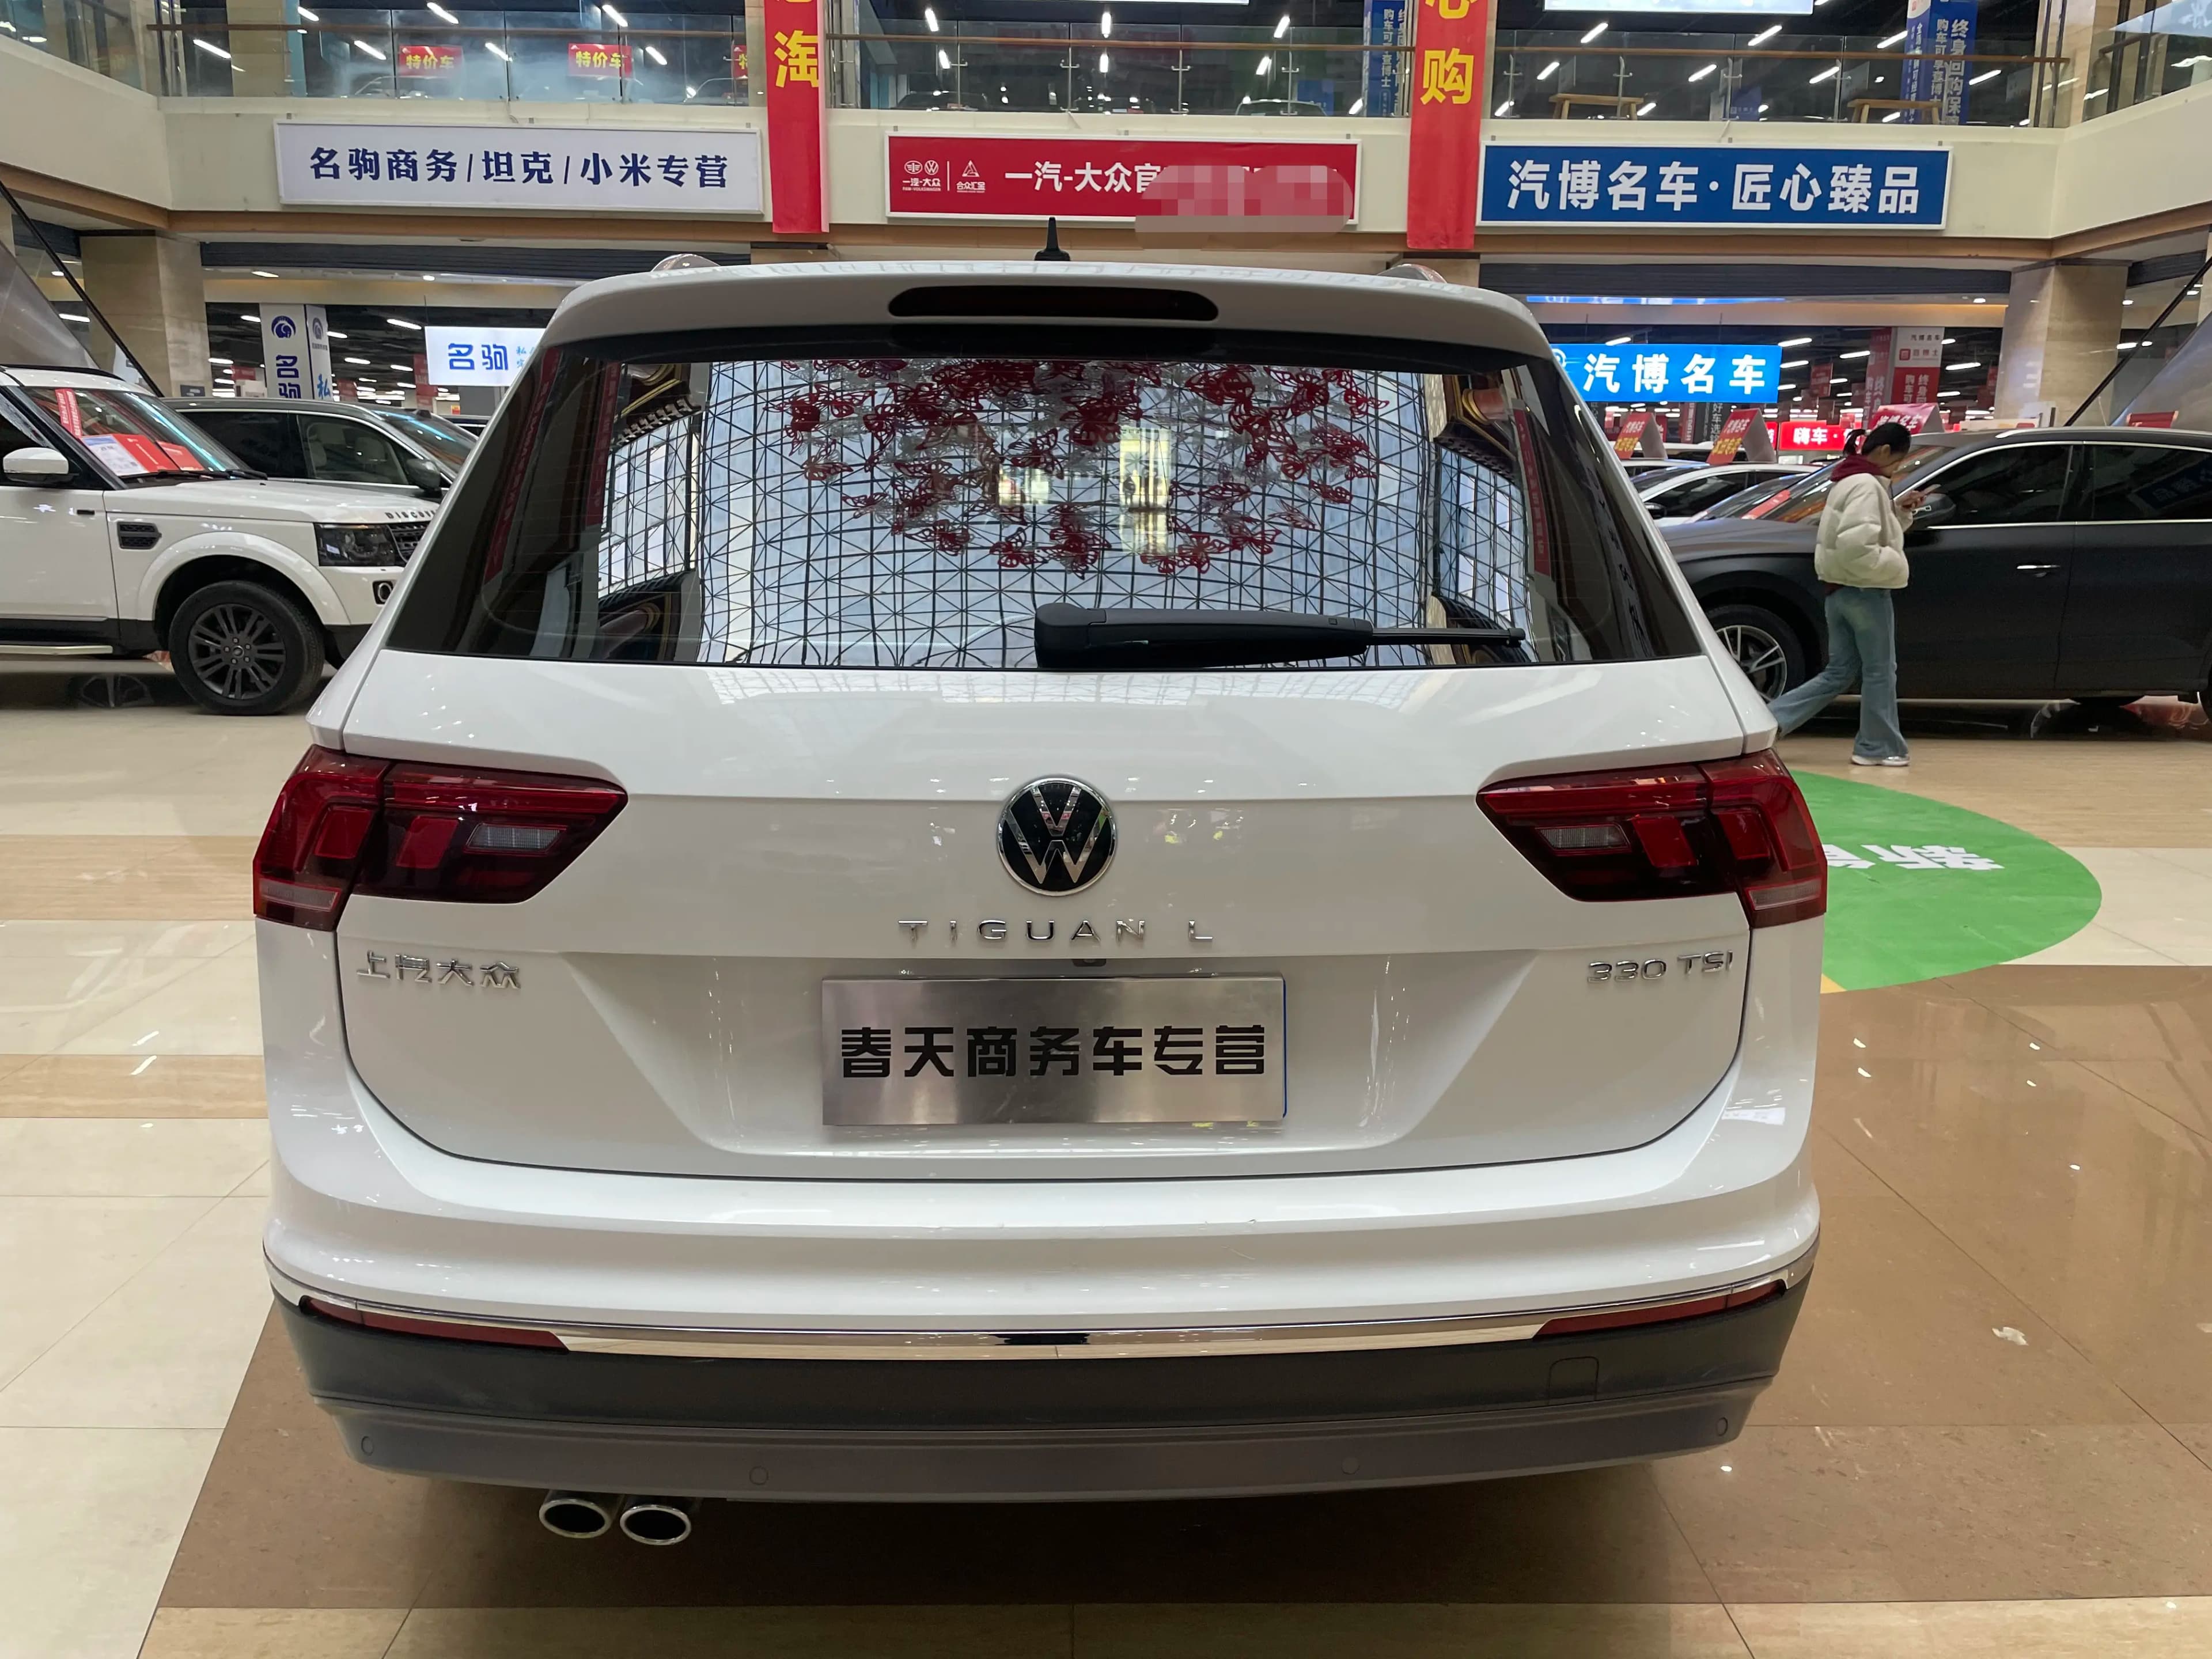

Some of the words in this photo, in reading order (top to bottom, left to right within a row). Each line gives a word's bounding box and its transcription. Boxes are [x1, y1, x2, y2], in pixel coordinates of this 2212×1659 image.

[406, 54, 454, 69] 特价车
[576, 51, 624, 69] 特价车
[774, 0, 819, 88] 淘
[310, 146, 728, 188] 名驹商务/坦克/小米专营
[1507, 160, 1919, 214] 汽博名车·匠心臻品
[449, 343, 509, 370] 名驹
[1583, 347, 1766, 395] 汽博名车
[898, 920, 1146, 942] TIGUAN
[1188, 920, 1213, 940] L
[356, 950, 521, 988] 上汽大众
[1588, 959, 1666, 982] 330
[1677, 949, 1733, 975] TSI
[841, 1025, 1265, 1078] 春天商务车专营
